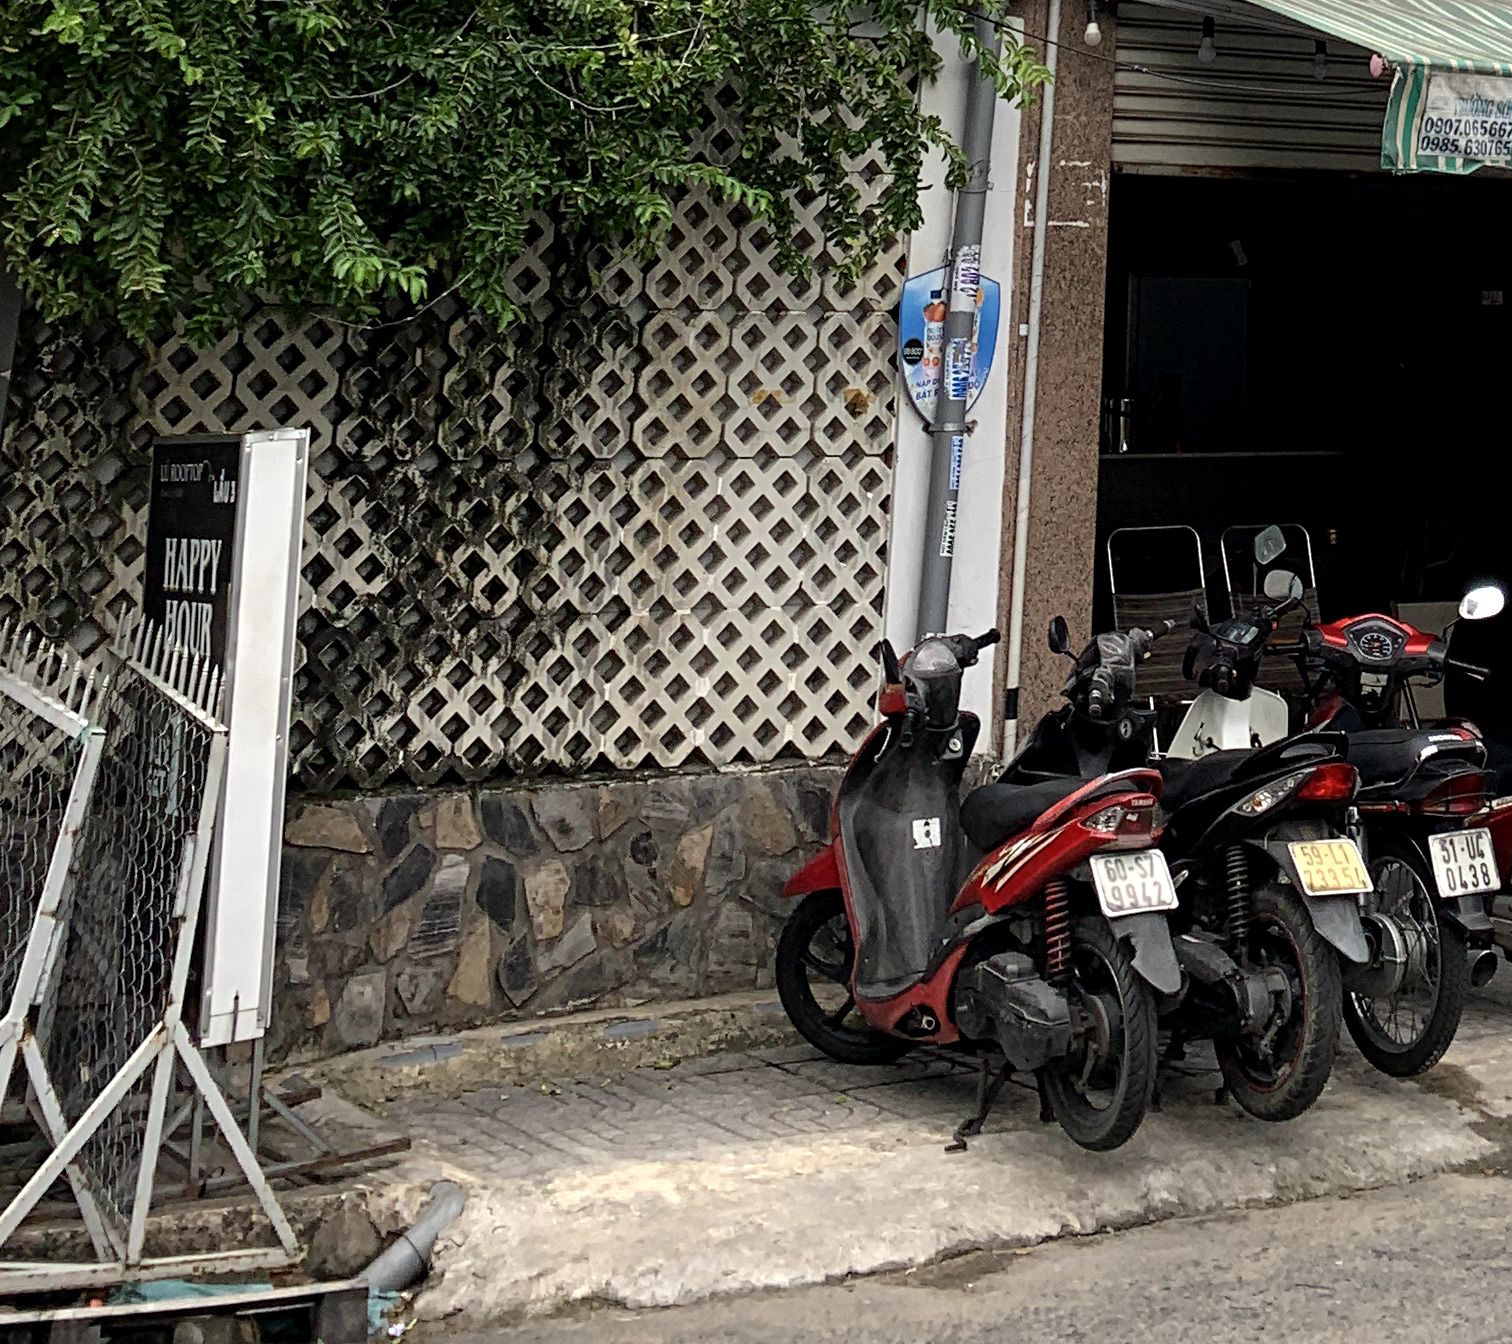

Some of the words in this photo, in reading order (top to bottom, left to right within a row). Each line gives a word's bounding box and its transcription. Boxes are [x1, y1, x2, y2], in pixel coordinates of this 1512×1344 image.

[1420, 136, 1512, 156] 0985.630765
[163, 538, 222, 594] HAPPY
[164, 599, 213, 657] HOUR
[1300, 843, 1351, 866] 59-L1
[1446, 862, 1491, 891] 0438
